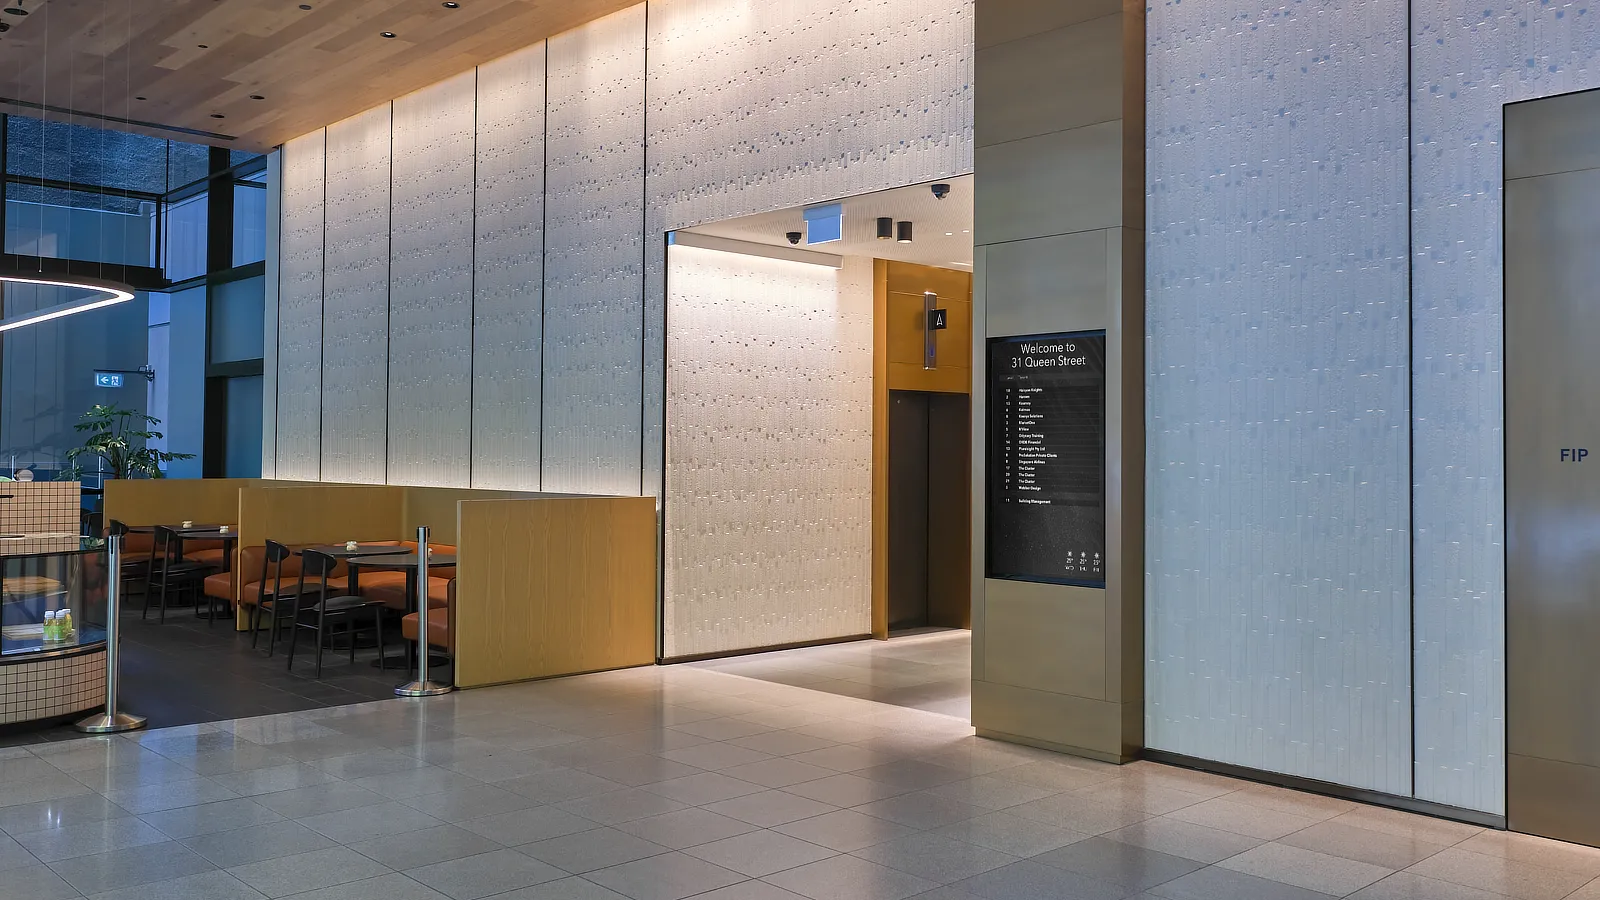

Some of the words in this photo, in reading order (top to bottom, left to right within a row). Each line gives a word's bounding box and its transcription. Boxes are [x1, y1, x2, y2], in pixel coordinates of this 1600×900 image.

[936, 313, 943, 326] A
[1020, 343, 1063, 354] Welcome
[1066, 343, 1076, 352] to
[1012, 357, 1021, 368] 31
[1025, 356, 1056, 368] Queen
[1058, 355, 1086, 366] Street
[1560, 448, 1588, 462] FIP
